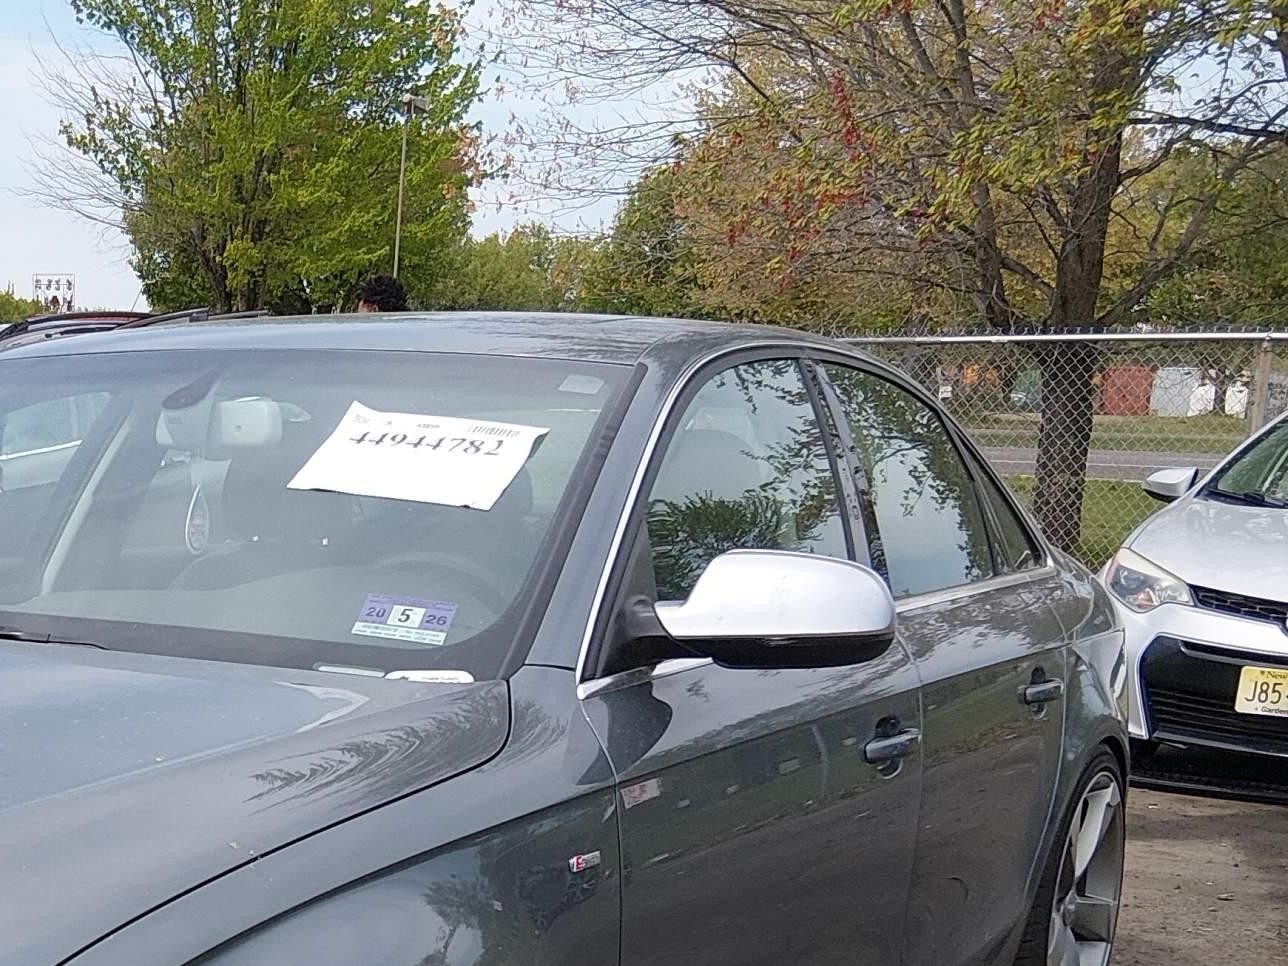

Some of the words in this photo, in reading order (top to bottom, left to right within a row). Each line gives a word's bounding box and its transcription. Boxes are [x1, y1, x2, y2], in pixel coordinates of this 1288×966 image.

[349, 431, 505, 456] 44944782
[365, 606, 387, 618] 20
[397, 608, 415, 623] 5
[425, 614, 449, 626] 26
[1244, 680, 1288, 705] J85
